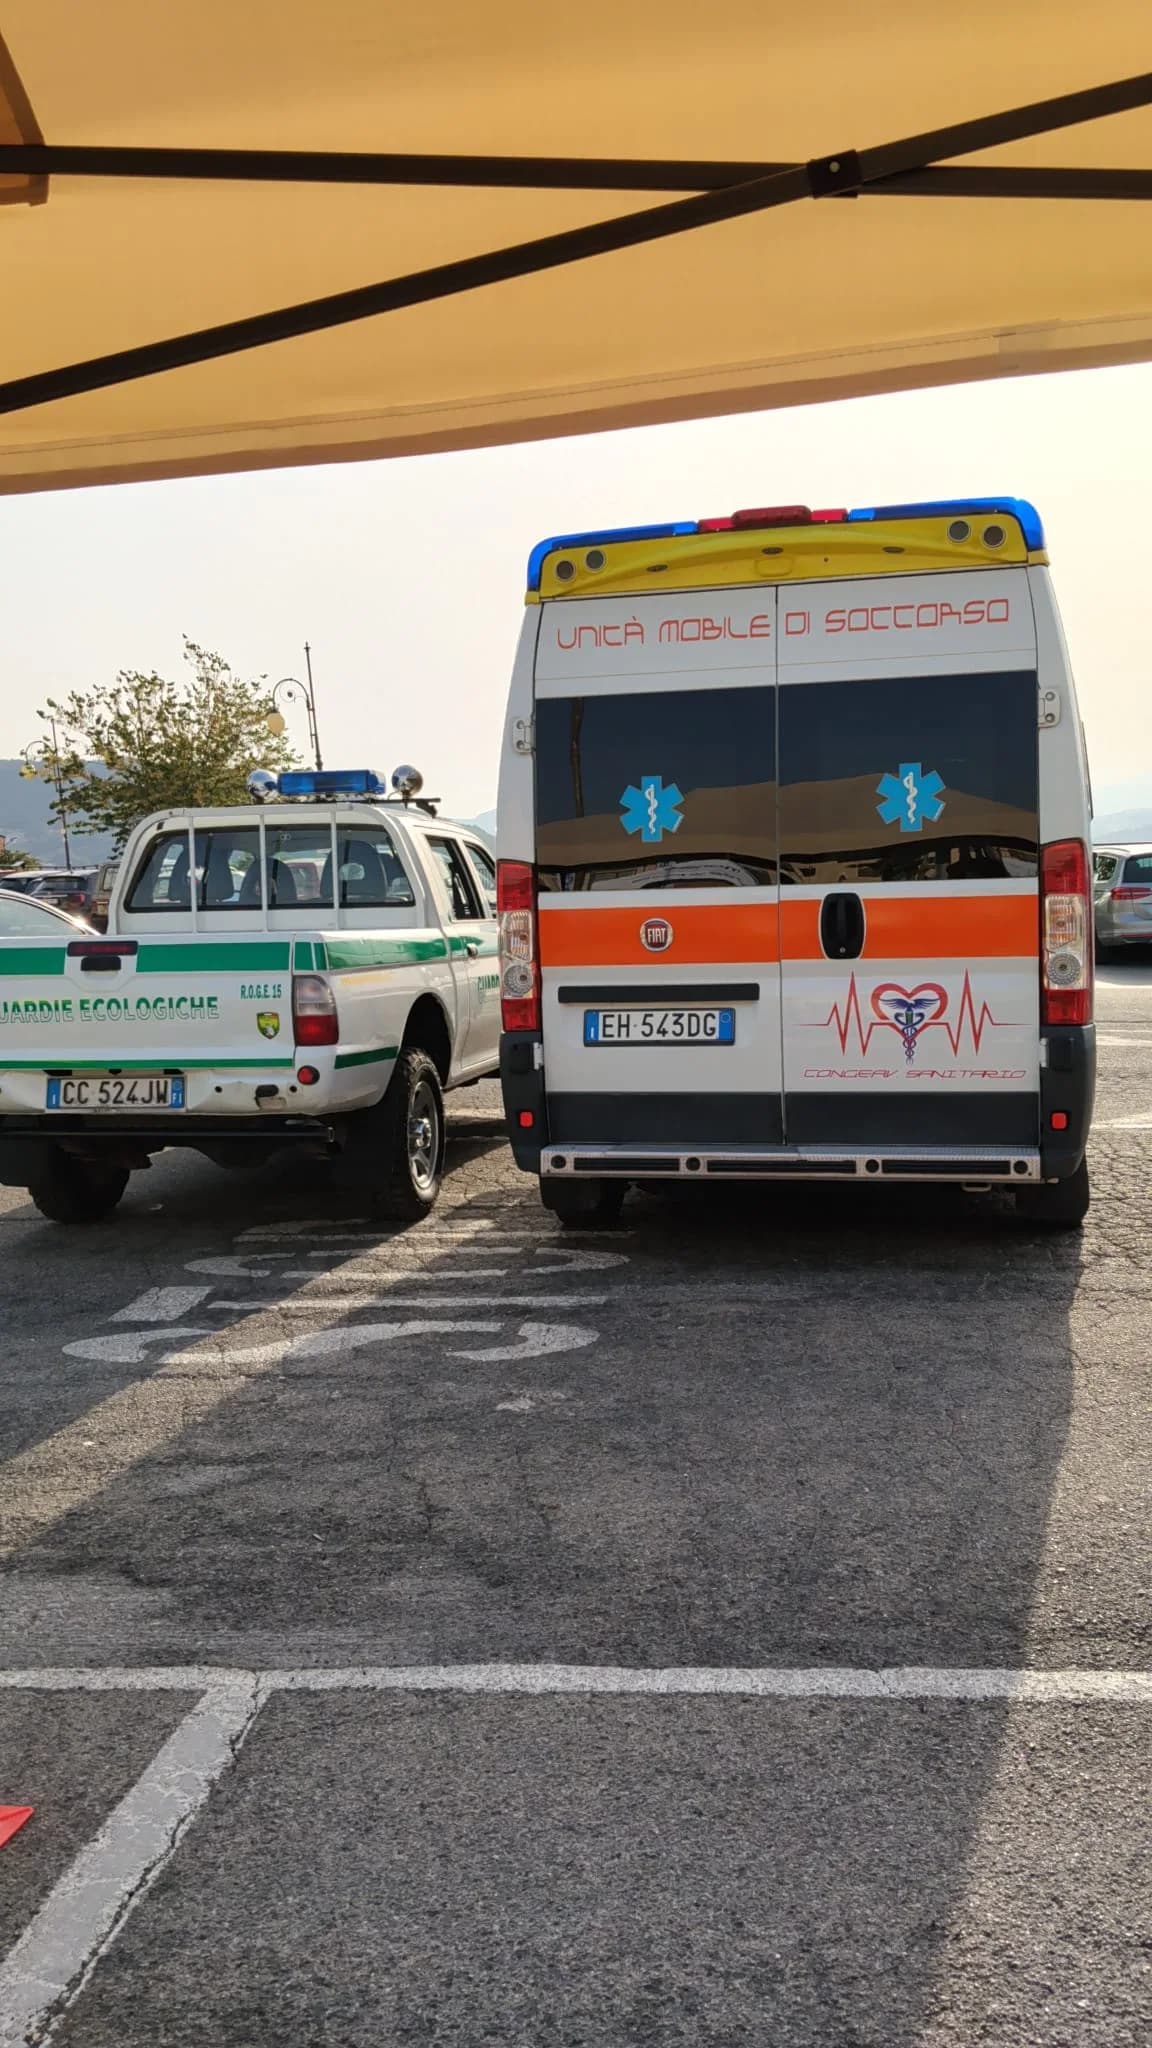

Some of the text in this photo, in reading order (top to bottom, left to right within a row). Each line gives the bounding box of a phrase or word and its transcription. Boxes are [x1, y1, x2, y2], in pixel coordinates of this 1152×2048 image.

[659, 614, 771, 643] MOBILE
[785, 611, 810, 635] DI
[825, 598, 1009, 633] SOCCORSO
[647, 927, 666, 944] FIAT
[272, 983, 282, 999] 15
[79, 997, 220, 1022] ECOLOGICHE
[602, 1013, 630, 1038] EH
[641, 1013, 716, 1037] 543DG
[905, 1069, 1027, 1079] SANITARIO
[63, 1080, 90, 1105] CC
[98, 1079, 169, 1104] 524JW
